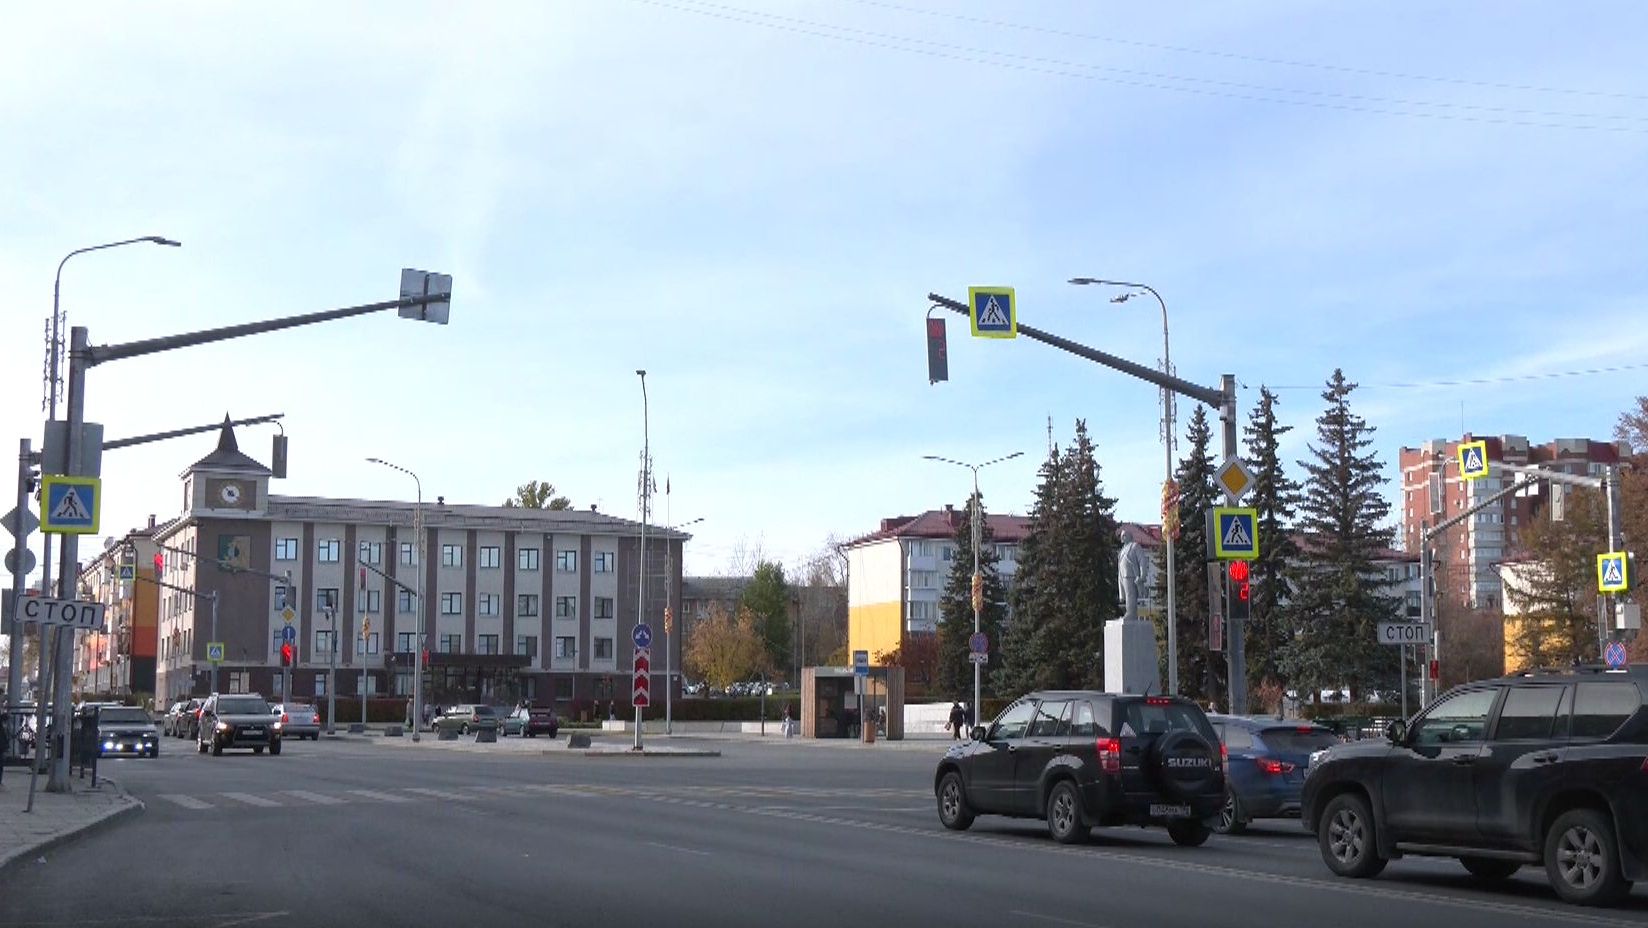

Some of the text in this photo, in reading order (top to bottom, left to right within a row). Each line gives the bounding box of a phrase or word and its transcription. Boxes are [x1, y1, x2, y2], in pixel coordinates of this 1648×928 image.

[1240, 582, 1249, 600] 2
[25, 600, 96, 625] СТОП
[1386, 625, 1424, 640] СТОП
[1167, 757, 1212, 768] SUZUKI
